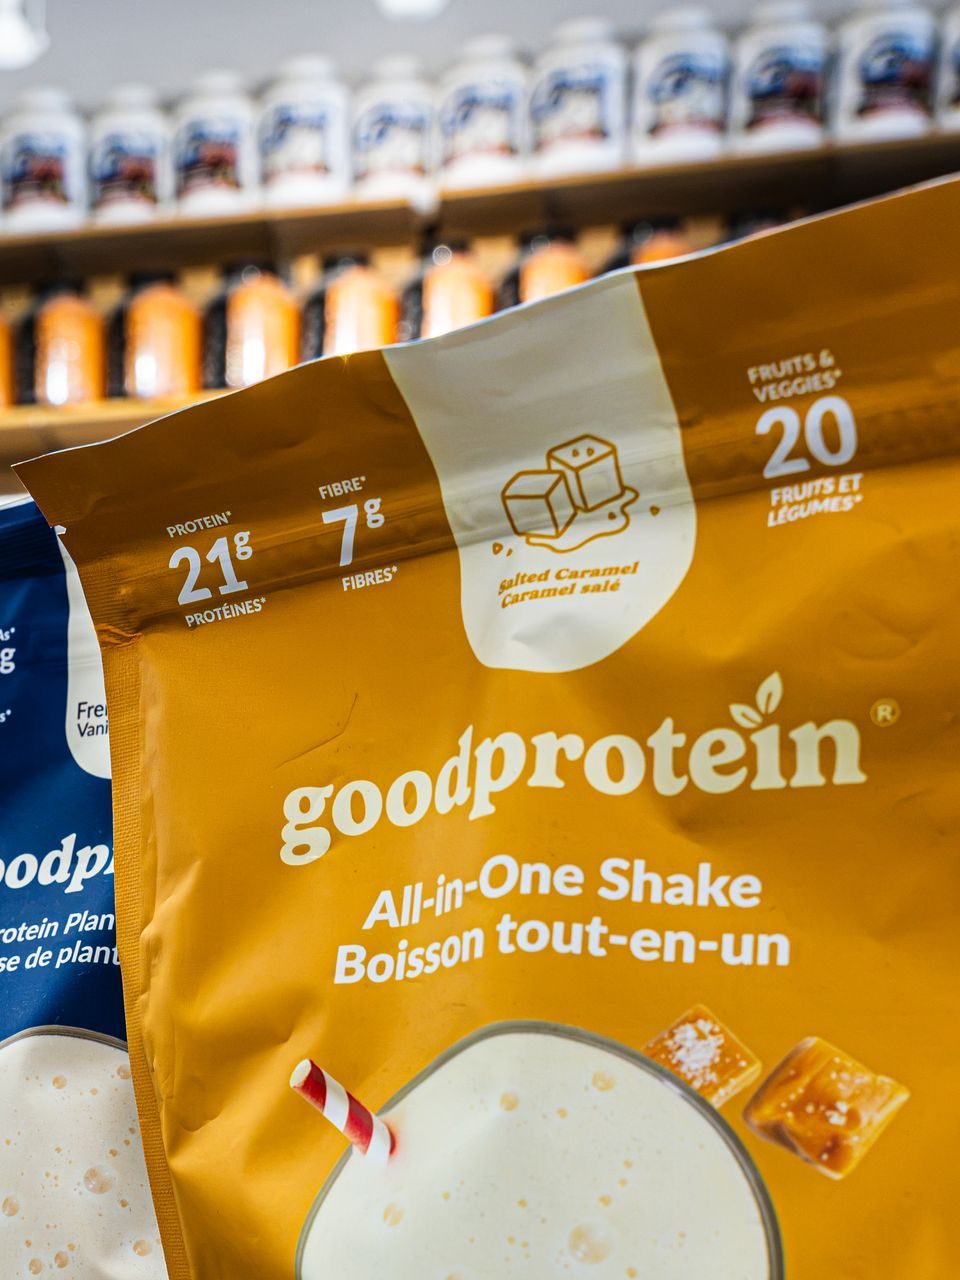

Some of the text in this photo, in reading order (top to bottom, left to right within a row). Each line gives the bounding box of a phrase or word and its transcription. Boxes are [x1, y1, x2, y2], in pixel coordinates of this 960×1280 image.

[747, 348, 835, 384] FRUITS &
[755, 395, 858, 479] 20
[770, 473, 864, 507] FRUITS ET
[497, 561, 640, 596] Salted Caramel
[500, 578, 621, 609] Caramel salé
[280, 672, 867, 866] goodprotein
[363, 854, 763, 930] All-in-One Shake
[24, 946, 52, 968] de
[333, 913, 791, 985] Boisson tout-en-un
